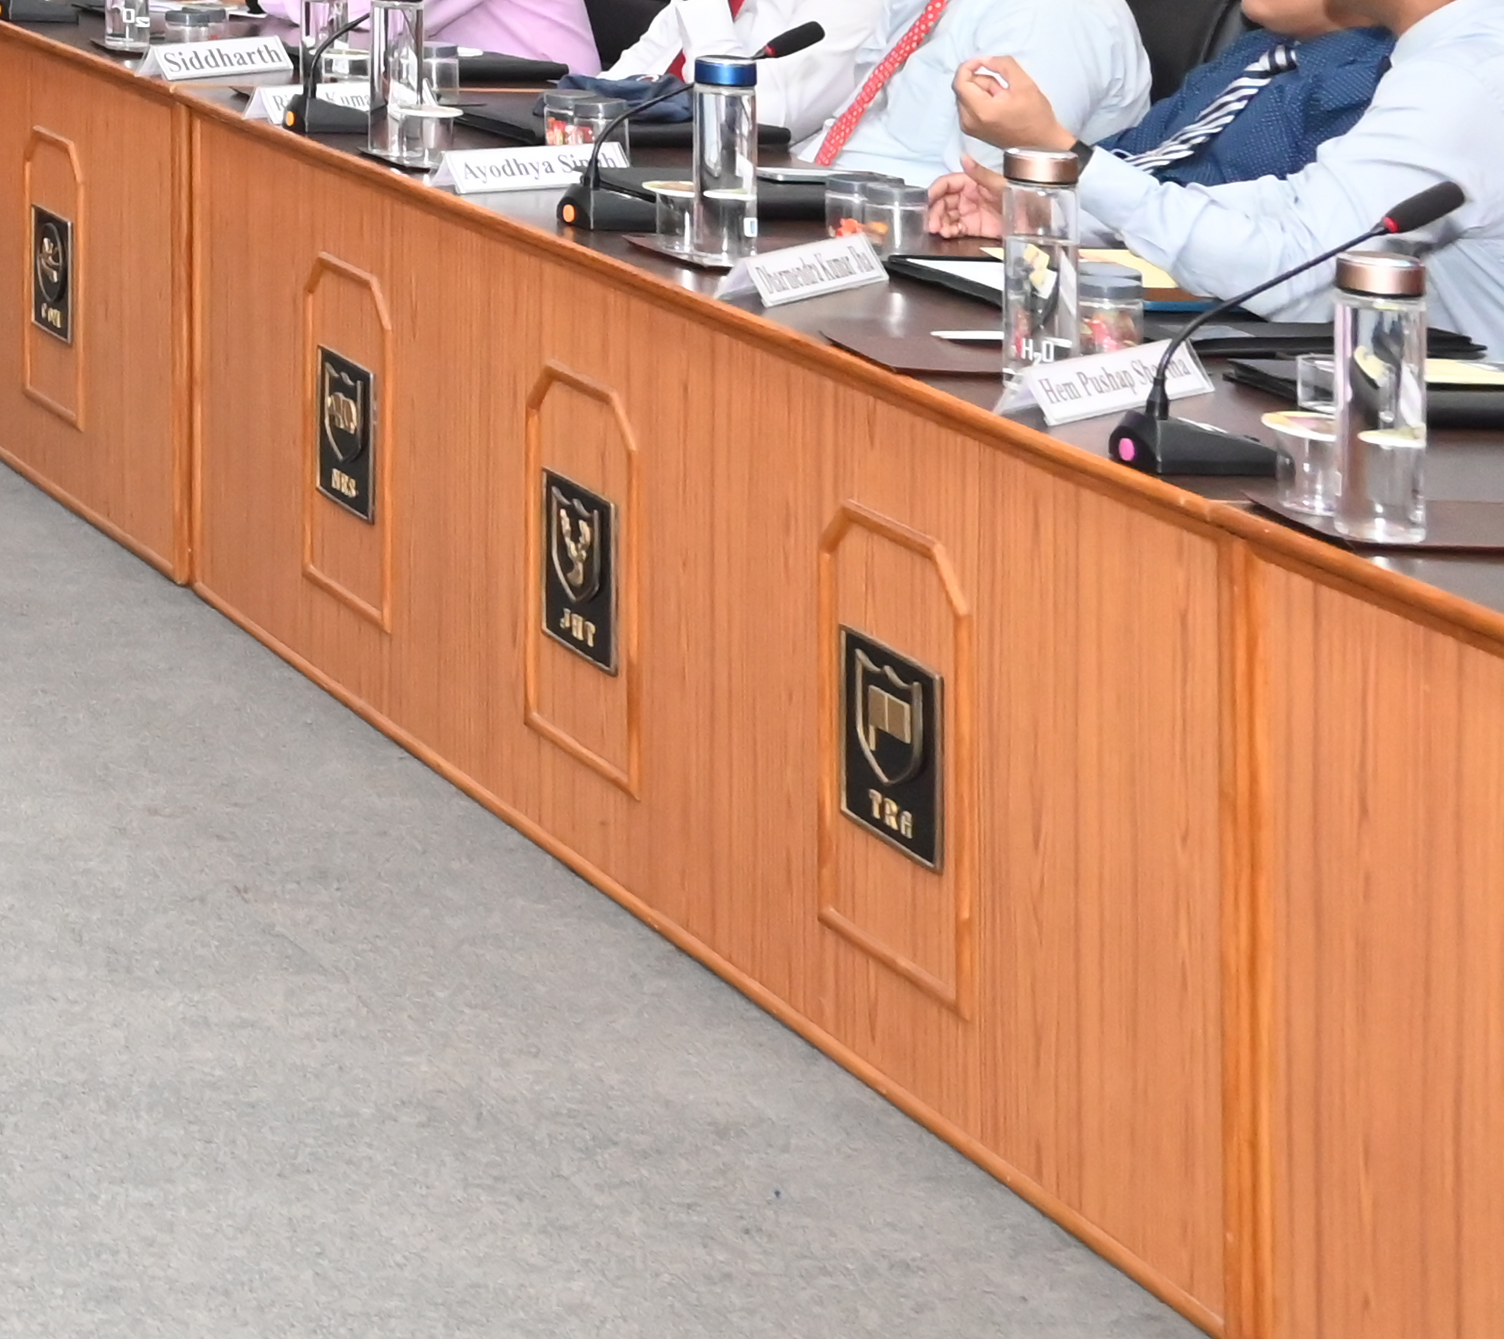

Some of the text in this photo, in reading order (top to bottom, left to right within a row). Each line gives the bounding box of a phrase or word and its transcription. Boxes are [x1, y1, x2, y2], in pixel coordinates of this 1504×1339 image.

[163, 44, 284, 73] Siddharth
[463, 153, 556, 185] Ayodhya
[1039, 377, 1080, 404] Hem
[1079, 364, 1135, 397] Pushap
